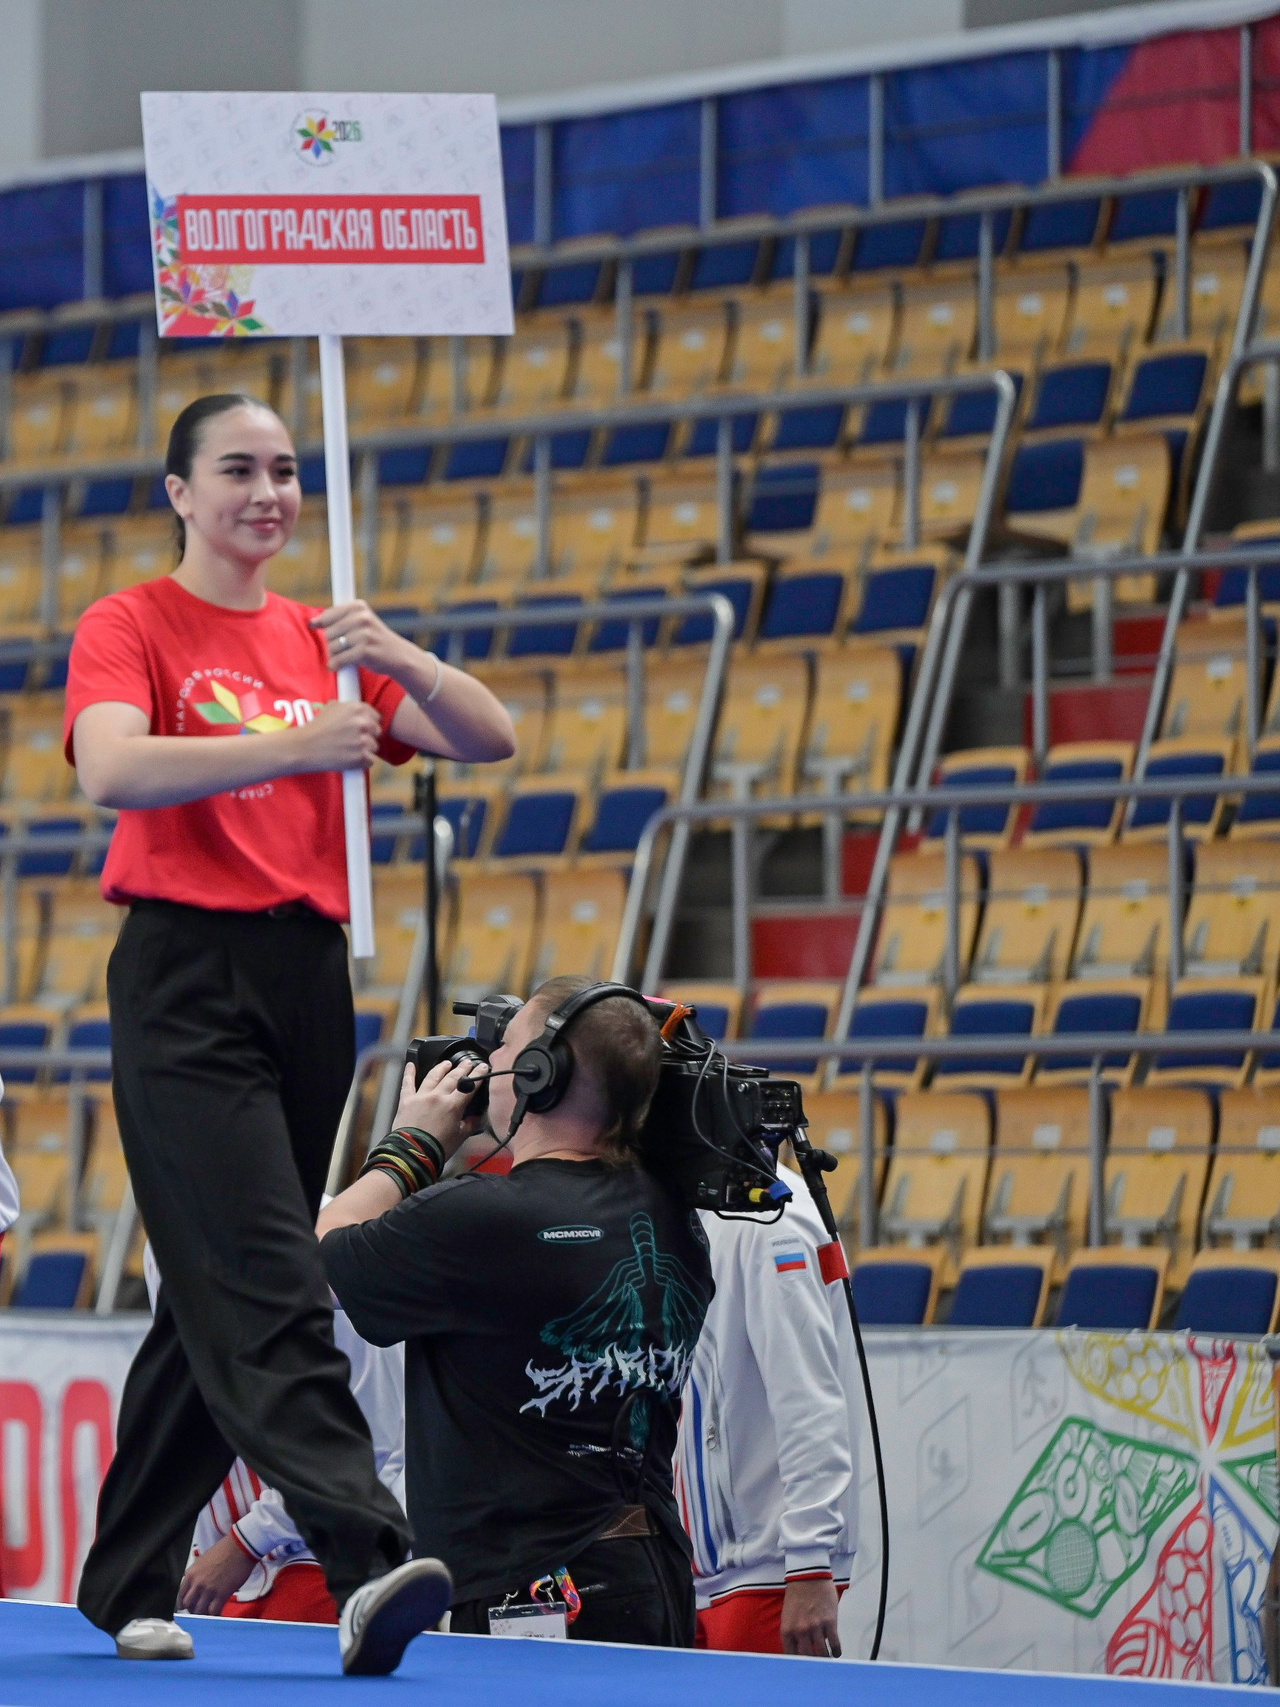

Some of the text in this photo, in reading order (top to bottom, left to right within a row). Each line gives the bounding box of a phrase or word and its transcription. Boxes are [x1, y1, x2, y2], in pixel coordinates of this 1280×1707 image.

[332, 120, 363, 142] 2026
[184, 208, 478, 251] ВОЛГОГРАДСКАЯ ОБЛАСТЬ
[204, 667, 265, 690] РОССИИ
